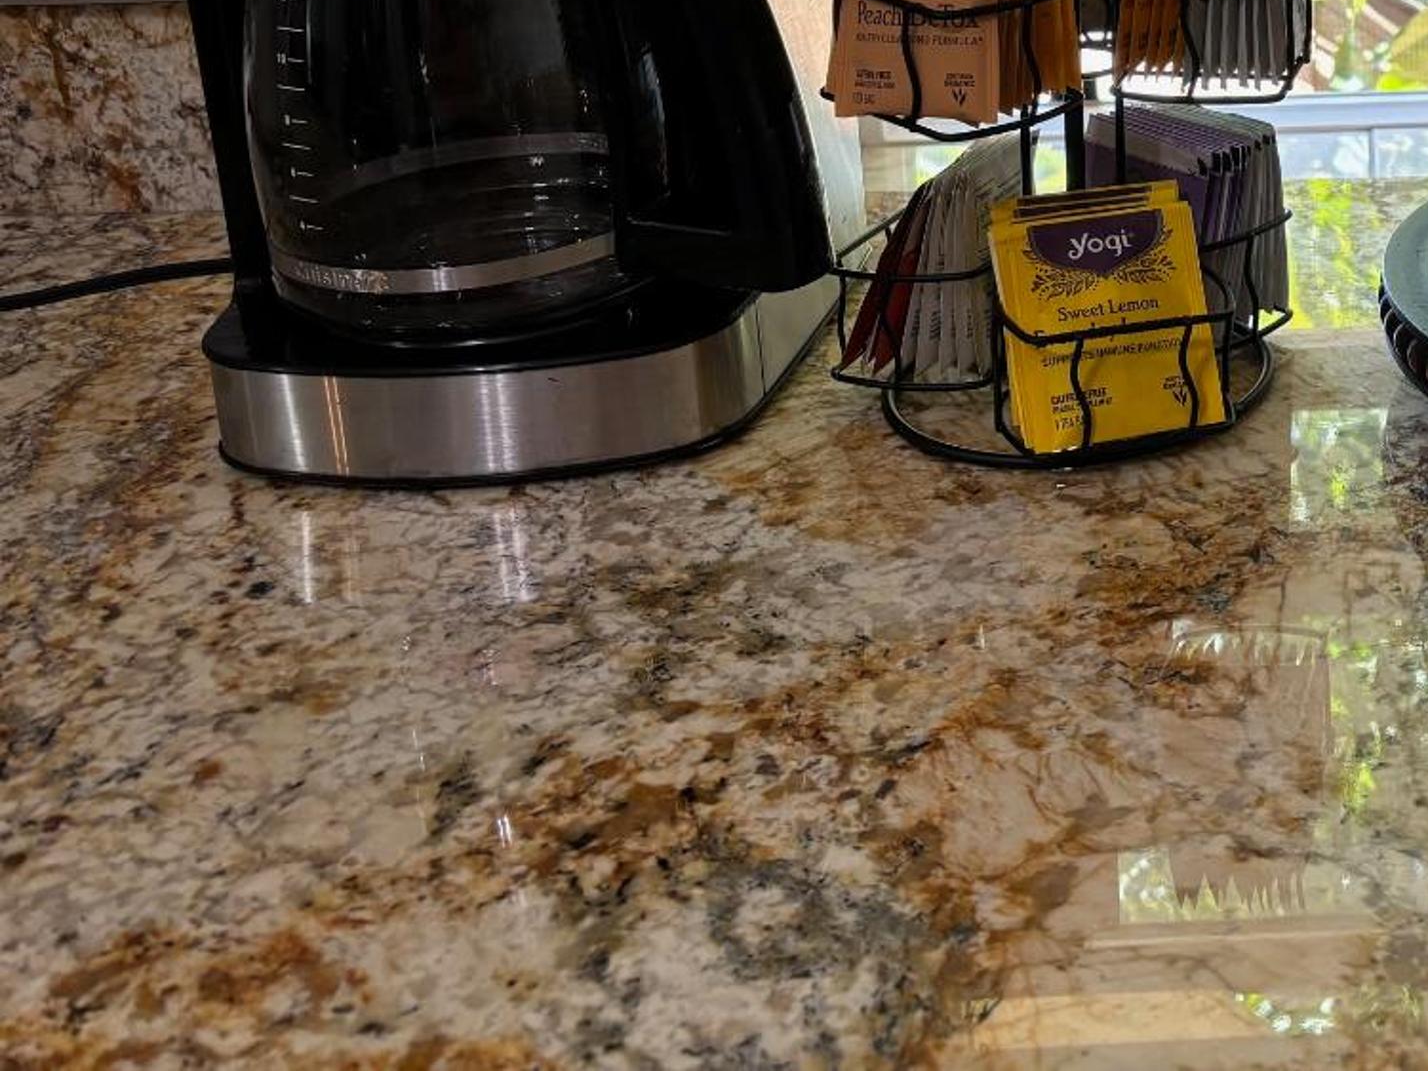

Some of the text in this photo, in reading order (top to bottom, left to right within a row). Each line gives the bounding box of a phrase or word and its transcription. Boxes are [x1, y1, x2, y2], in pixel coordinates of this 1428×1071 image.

[857, 0, 902, 26] Peach
[1057, 298, 1159, 322] Sweet Lemon
